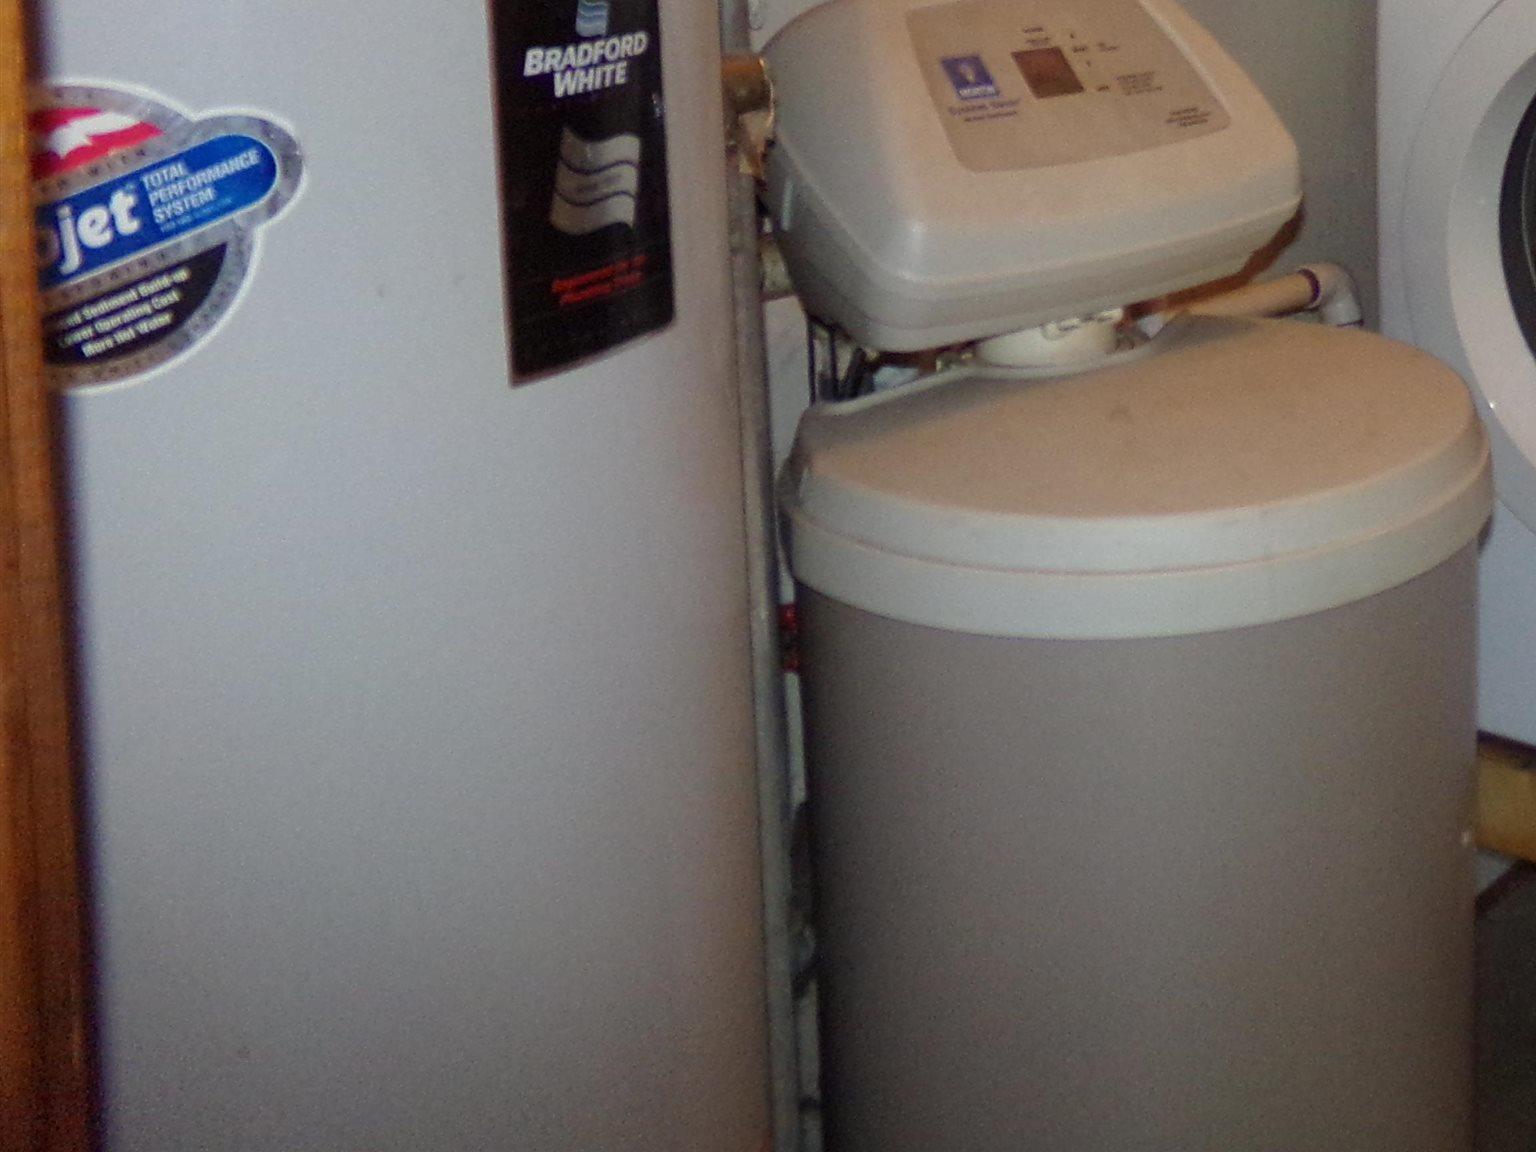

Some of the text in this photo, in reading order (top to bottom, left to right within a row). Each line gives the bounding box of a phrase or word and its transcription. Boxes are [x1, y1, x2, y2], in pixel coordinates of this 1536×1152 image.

[523, 29, 649, 78] BRADFORD
[553, 59, 629, 98] WHITE
[142, 161, 188, 191] TOTAL
[148, 148, 262, 207] PERFORMANCE
[152, 187, 216, 224] SYSTEM
[81, 335, 115, 358] More
[135, 310, 175, 335] Water
[94, 301, 155, 334] Operating
[151, 288, 181, 311] Cost
